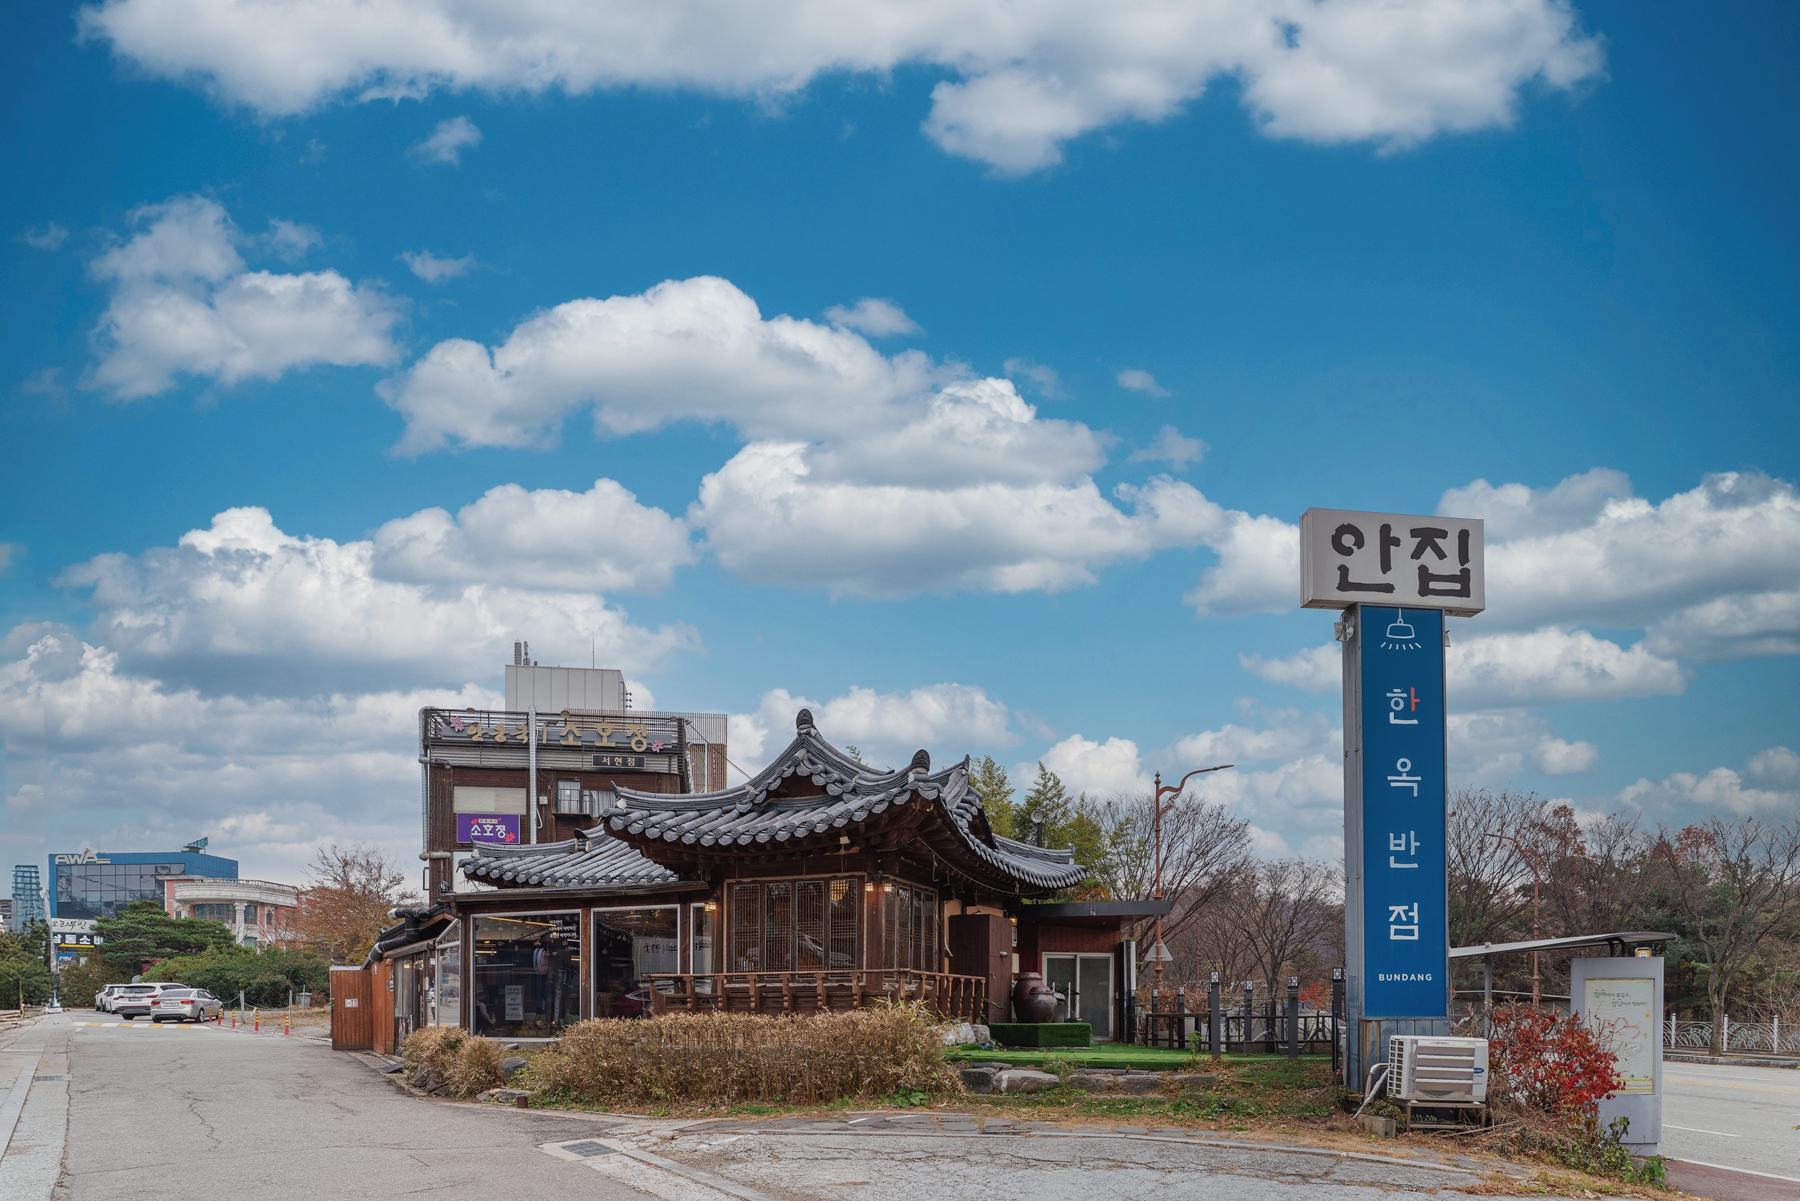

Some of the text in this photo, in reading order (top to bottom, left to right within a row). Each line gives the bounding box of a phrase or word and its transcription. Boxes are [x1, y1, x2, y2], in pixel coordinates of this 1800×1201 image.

[1331, 522, 1471, 598] 안집
[559, 721, 648, 753] 소호정
[601, 756, 635, 767] 서현점
[1386, 687, 1421, 940] 한옥반점
[470, 823, 506, 839] 소호정
[1378, 973, 1433, 982] BUNDANG
